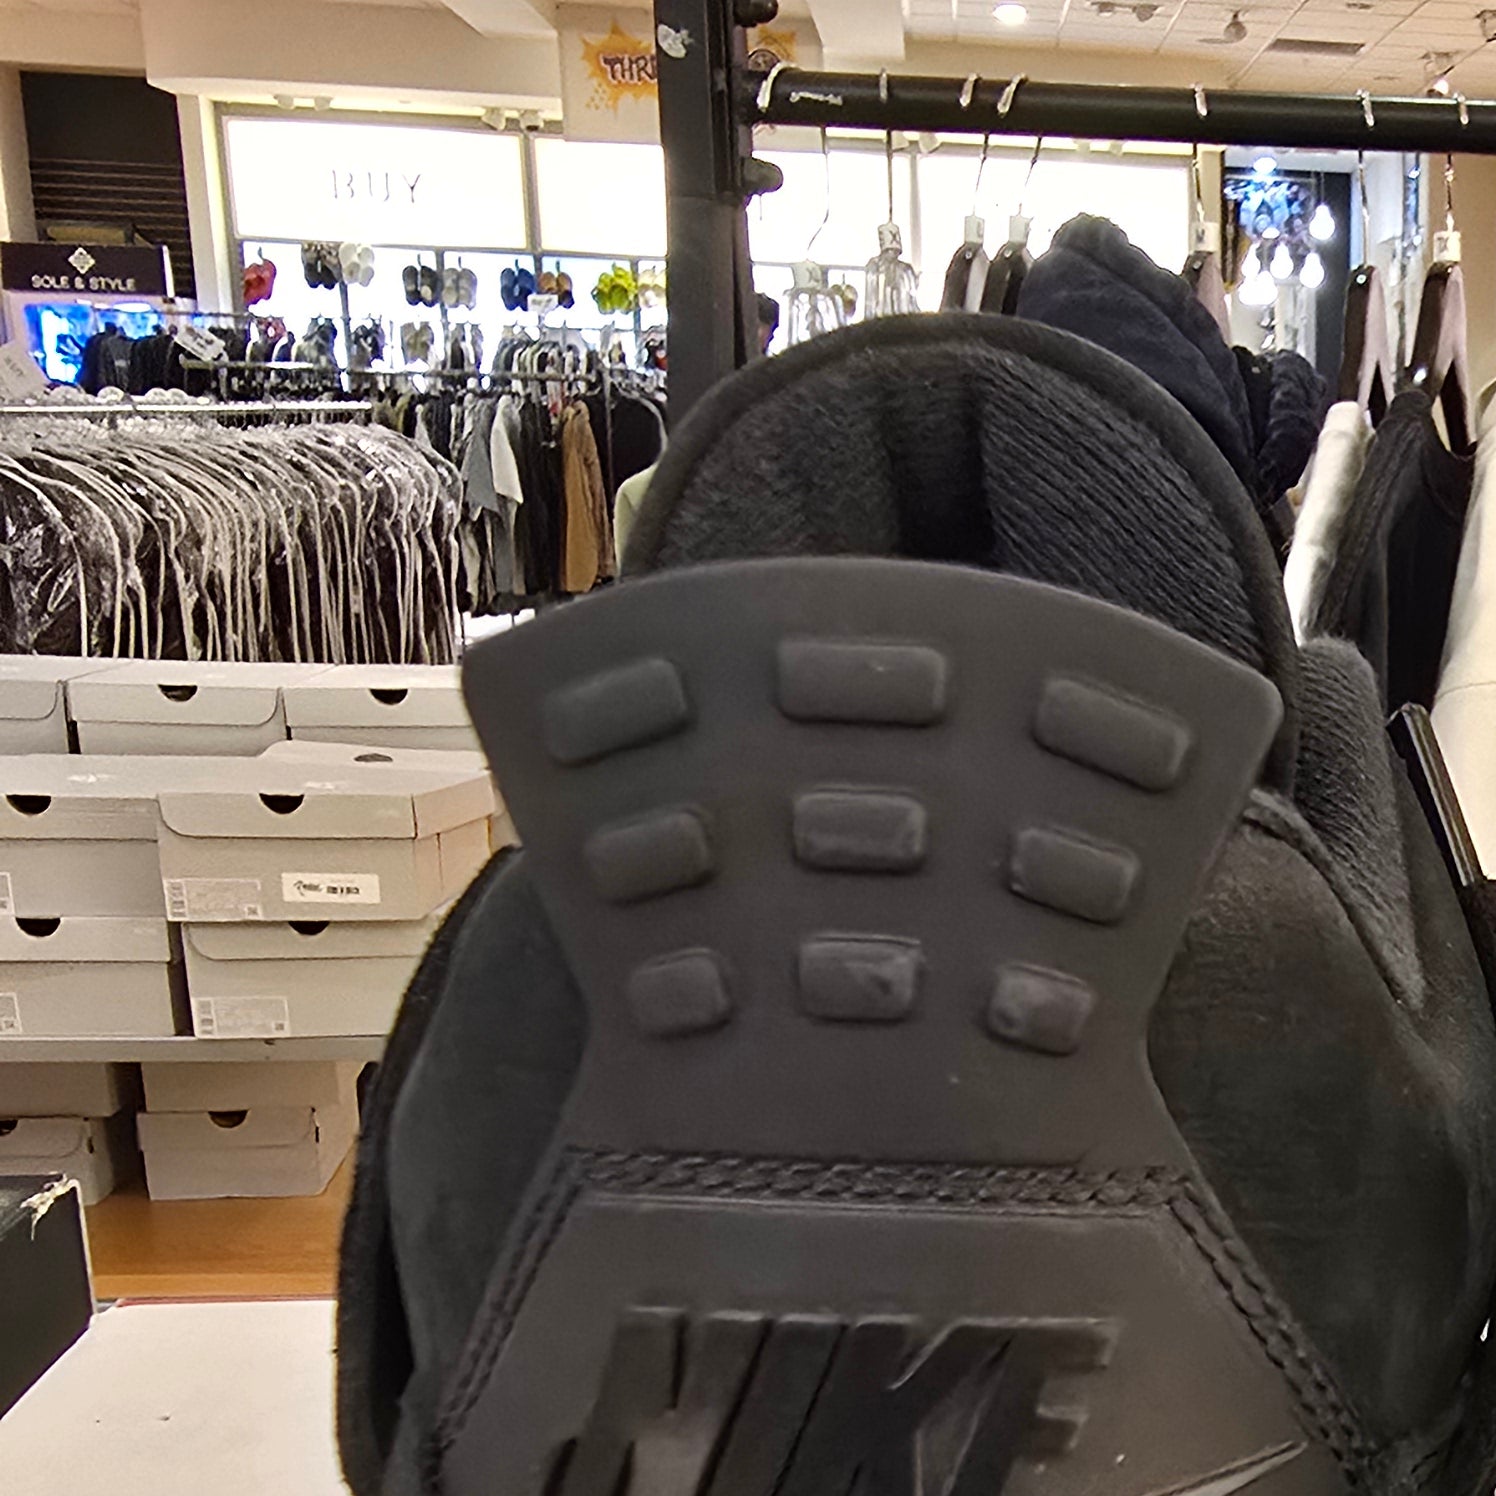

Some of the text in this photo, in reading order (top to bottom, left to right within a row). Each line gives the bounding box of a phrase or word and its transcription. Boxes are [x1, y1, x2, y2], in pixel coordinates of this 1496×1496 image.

[332, 169, 421, 203] BUY
[31, 275, 136, 291] SOLE & STYLE
